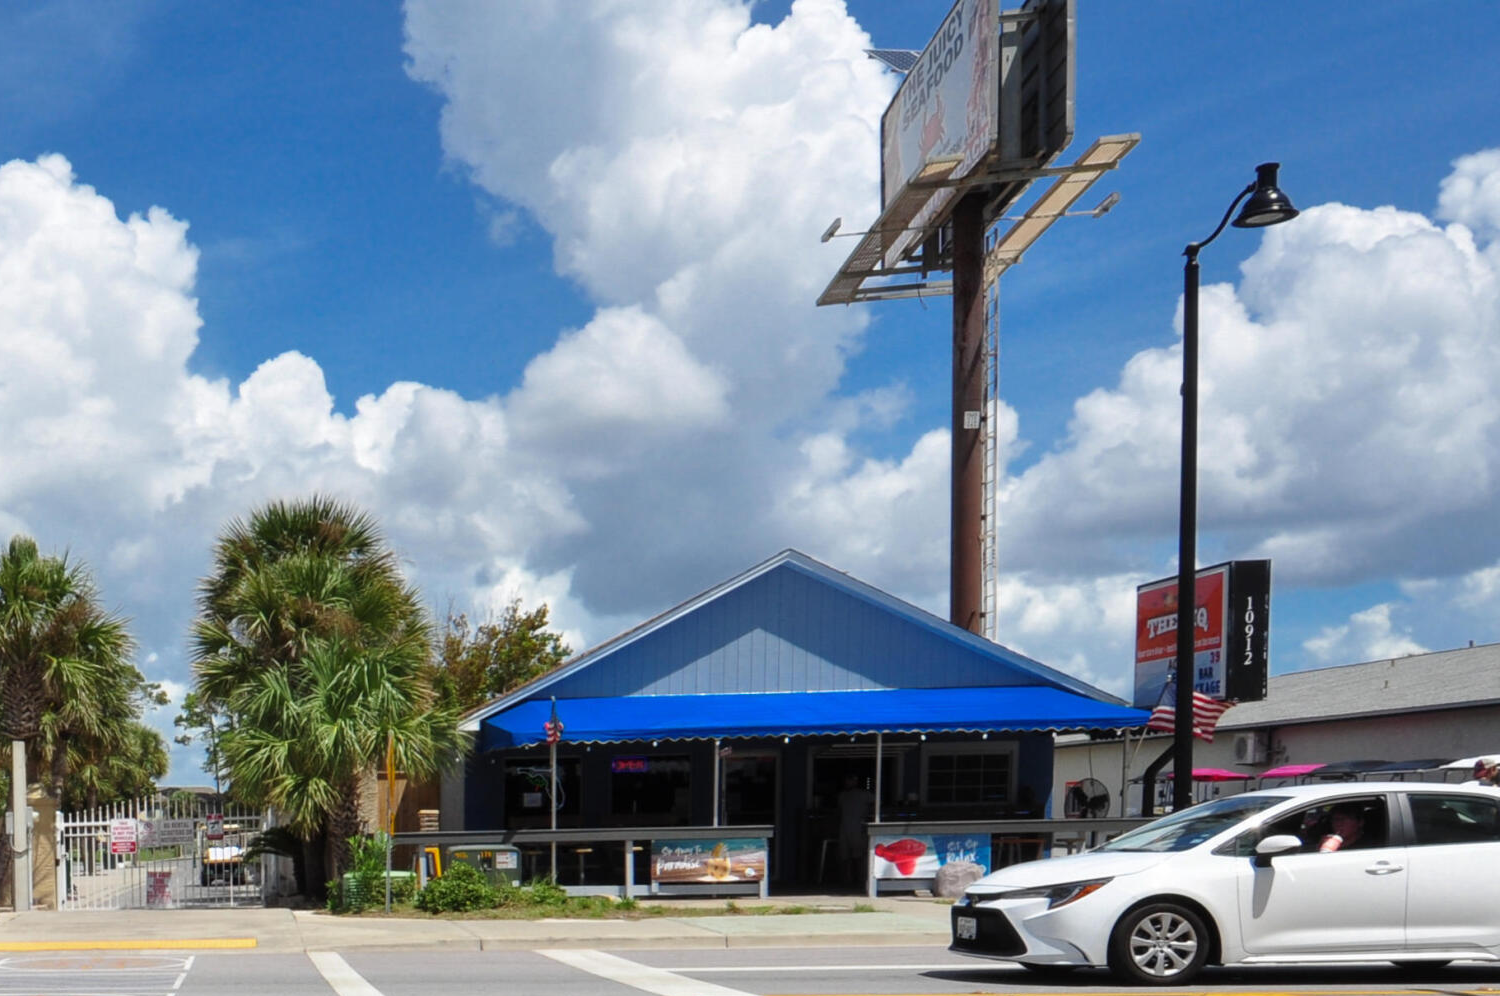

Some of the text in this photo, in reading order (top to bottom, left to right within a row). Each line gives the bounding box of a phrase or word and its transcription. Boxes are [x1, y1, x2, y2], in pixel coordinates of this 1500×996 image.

[902, 2, 965, 108] THE JUICY
[903, 33, 964, 133] SEAFOOD
[1199, 667, 1213, 680] BAR
[1243, 596, 1255, 666] 10912
